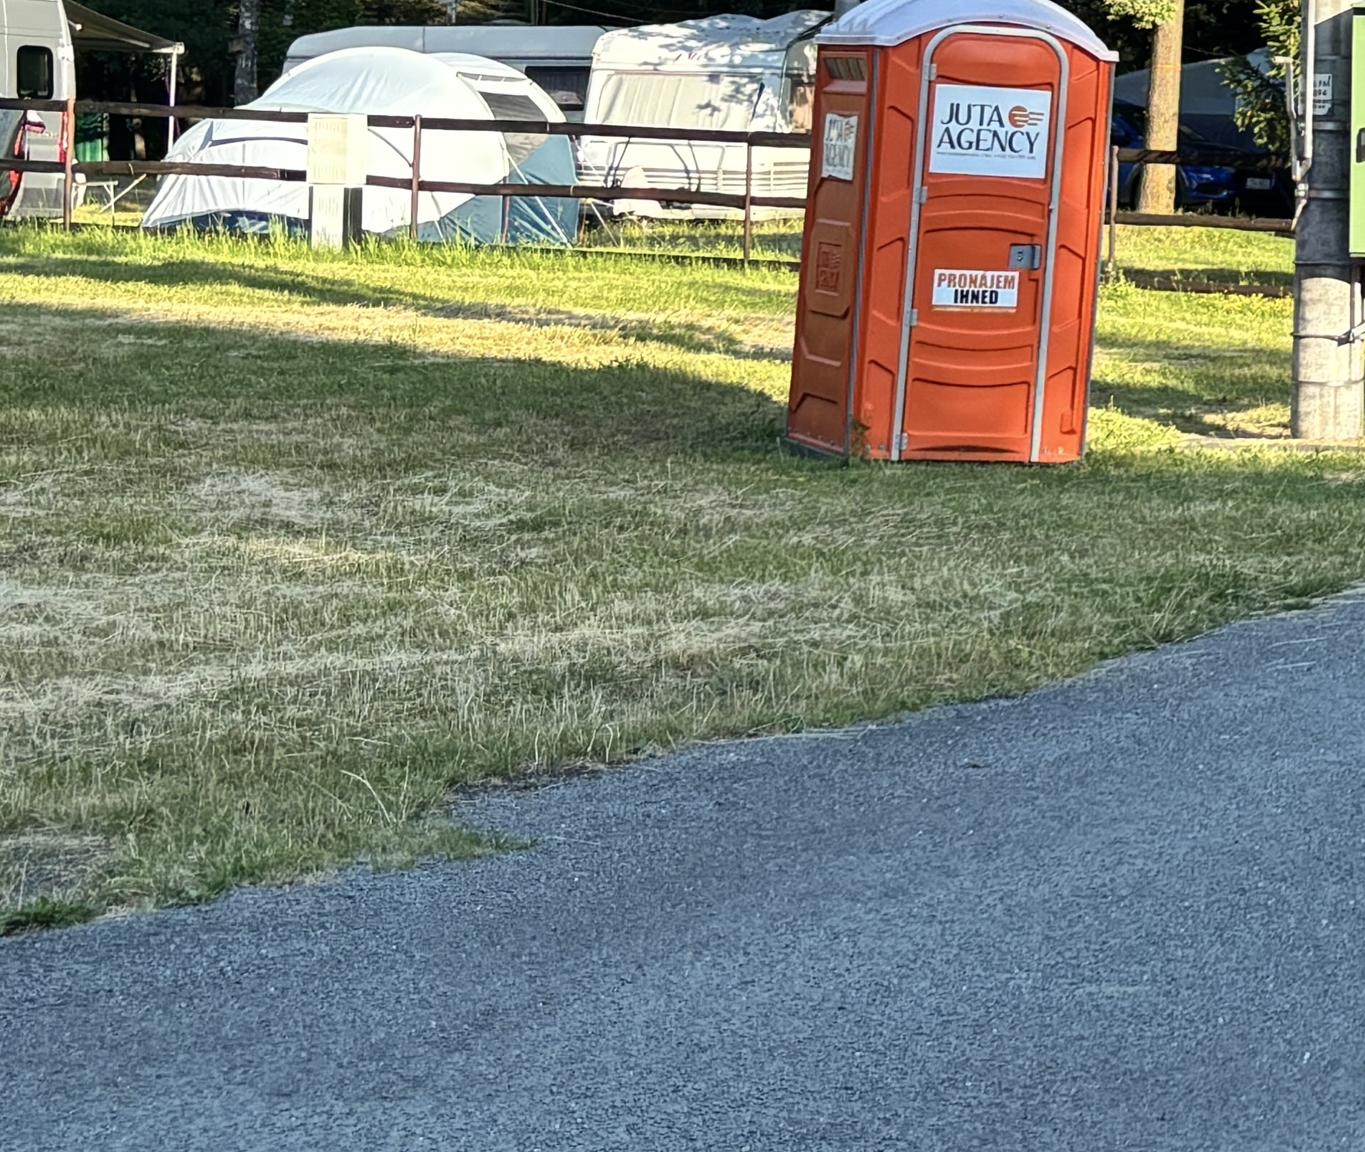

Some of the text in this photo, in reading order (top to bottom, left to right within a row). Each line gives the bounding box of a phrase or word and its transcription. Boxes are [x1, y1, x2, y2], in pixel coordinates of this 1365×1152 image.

[940, 102, 1005, 128] JUTA
[936, 126, 1040, 154] AGENCY
[936, 272, 1016, 289] PRONÁJEM
[953, 289, 999, 305] IHNED
